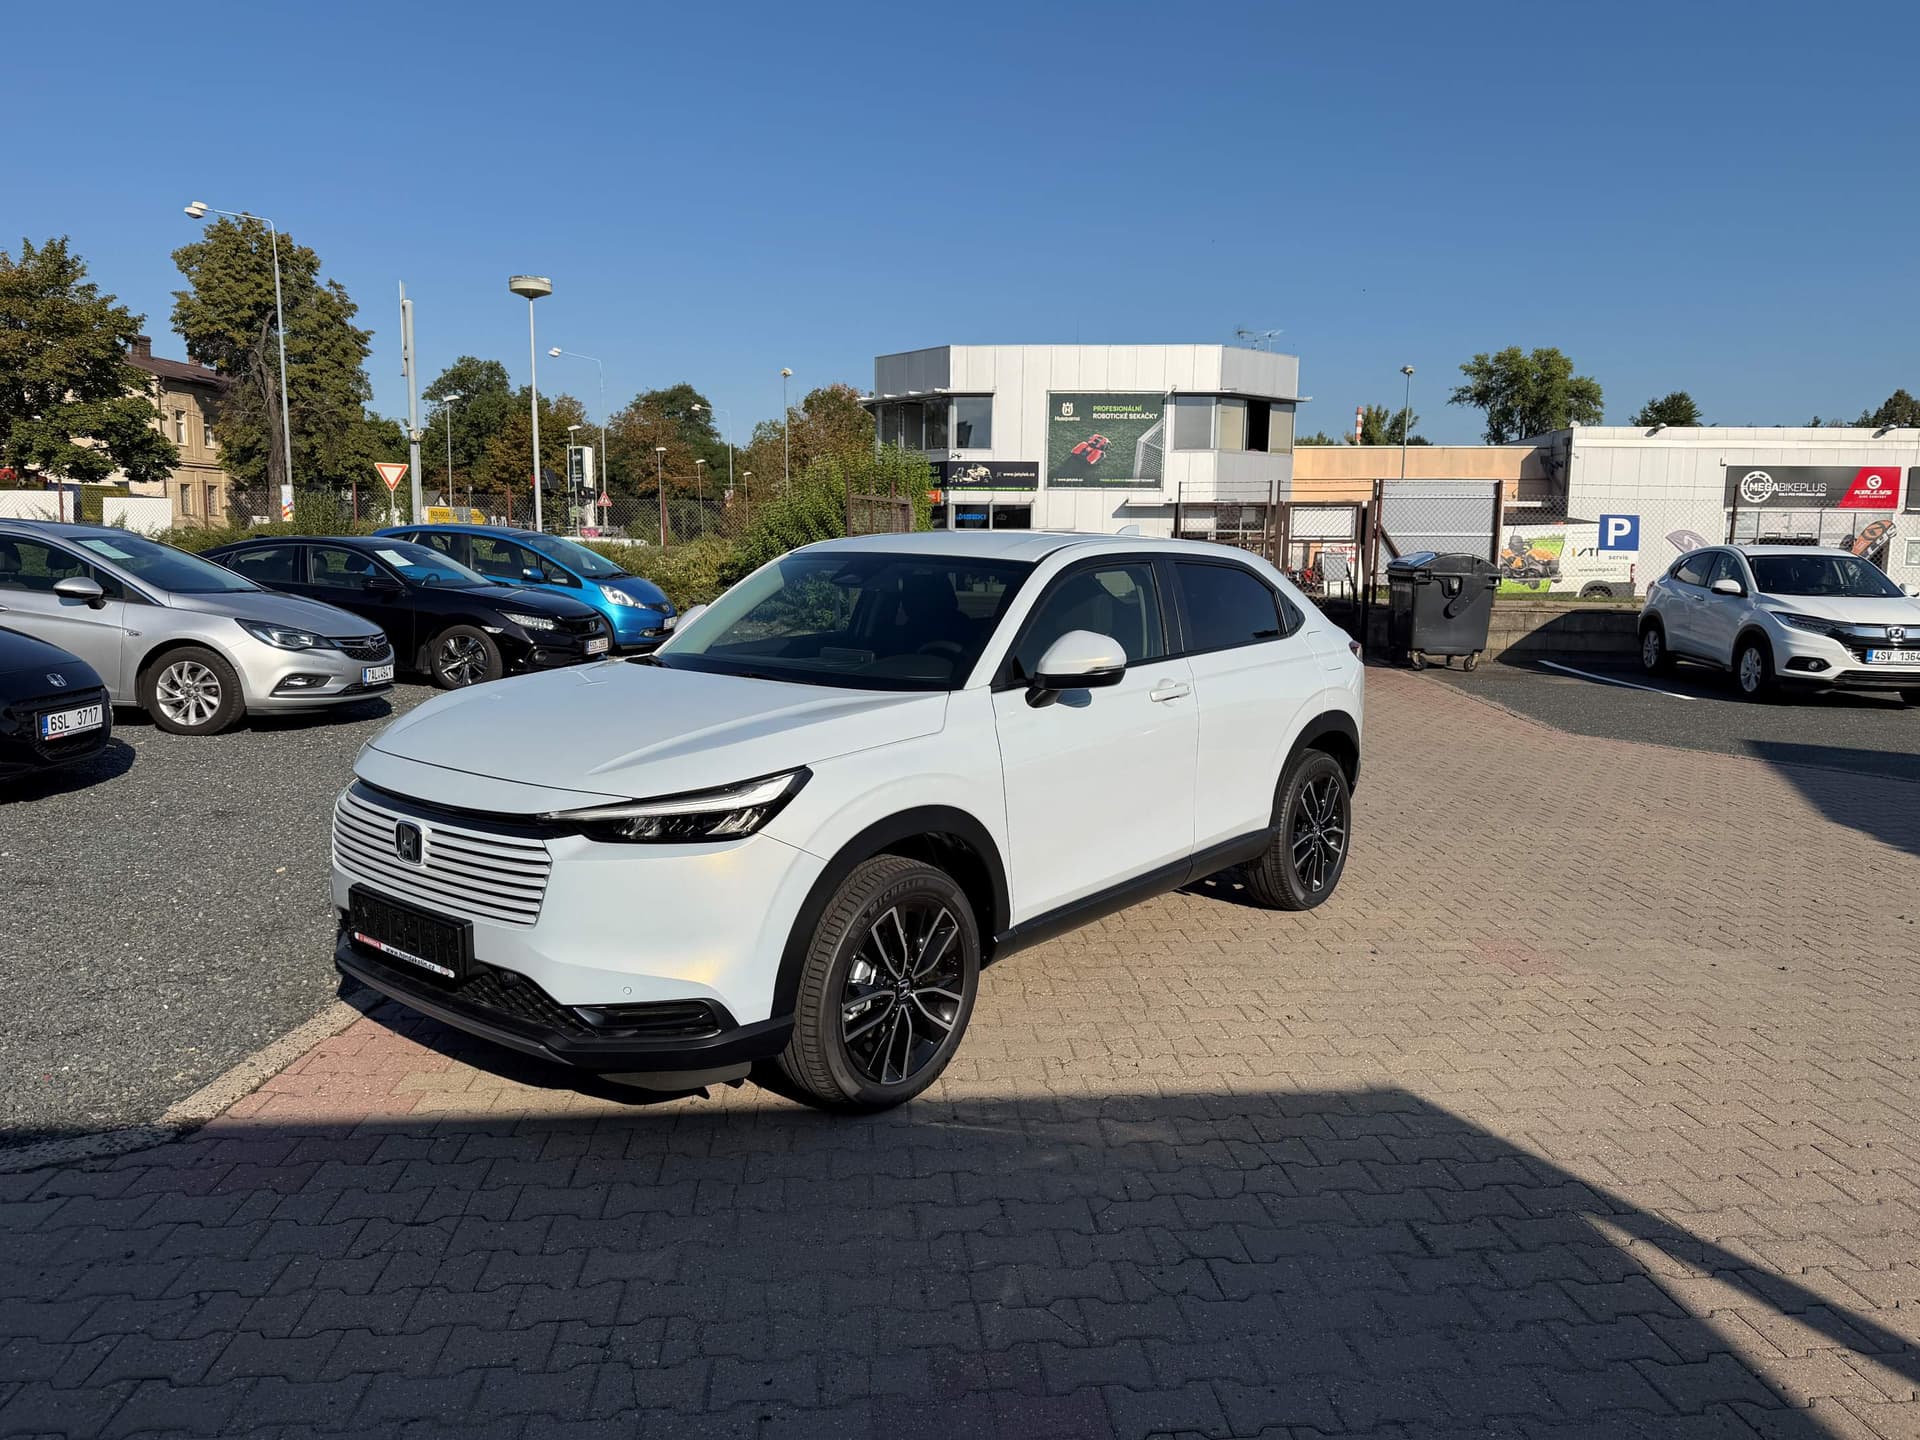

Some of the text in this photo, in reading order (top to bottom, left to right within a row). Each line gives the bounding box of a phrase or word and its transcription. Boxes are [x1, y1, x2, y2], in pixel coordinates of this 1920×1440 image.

[1092, 404, 1142, 412] PROFESIONÁLNÍ
[1092, 411, 1158, 420] ROBOTICKÉ SEKAČKY
[1749, 482, 1827, 493] MEGABIKEPLUS
[1607, 517, 1632, 546] P
[1874, 651, 1892, 660] 4SV
[50, 713, 70, 731] 6SL
[77, 707, 98, 726] 3717
